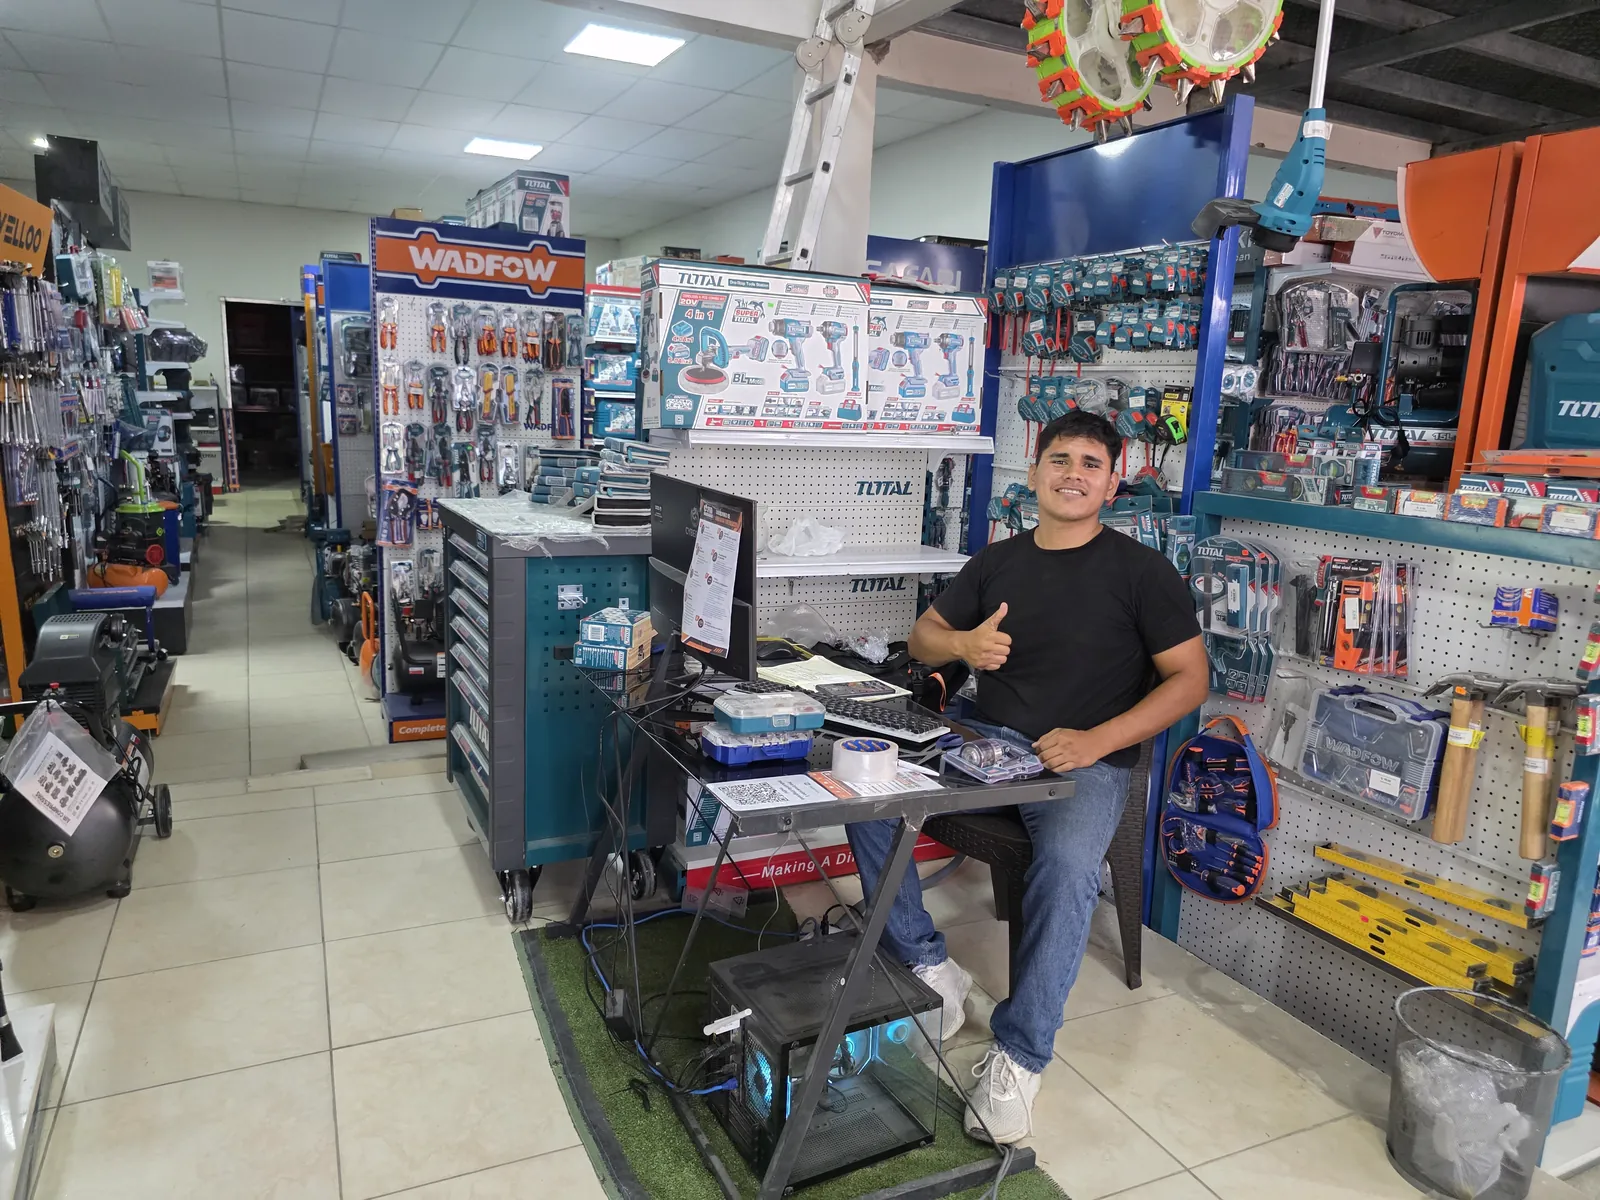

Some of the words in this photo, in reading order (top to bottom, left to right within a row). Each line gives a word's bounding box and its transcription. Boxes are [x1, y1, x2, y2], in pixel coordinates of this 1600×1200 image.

[524, 179, 552, 190] TOTAL
[408, 245, 557, 282] WADFOW
[678, 272, 725, 288] TOTAL
[680, 298, 698, 306] 20V
[685, 309, 693, 319] 4
[695, 310, 704, 319] in
[707, 311, 714, 320] 1
[735, 309, 759, 317] SUPER
[732, 373, 747, 384] BL
[1558, 400, 1600, 418] TOT
[524, 423, 552, 431] WADF
[1370, 429, 1427, 441] TOTAL
[856, 481, 913, 496] TOTAL
[1461, 484, 1488, 492] TOTAL
[1503, 486, 1529, 495] TOTAL
[1549, 493, 1579, 501] TOTAL
[1197, 546, 1225, 558] TOTAL
[851, 577, 907, 593] TOTAL
[398, 724, 446, 735] Complete
[1325, 736, 1400, 773] WADFOW
[761, 861, 816, 879] Making
[820, 855, 831, 868] A
